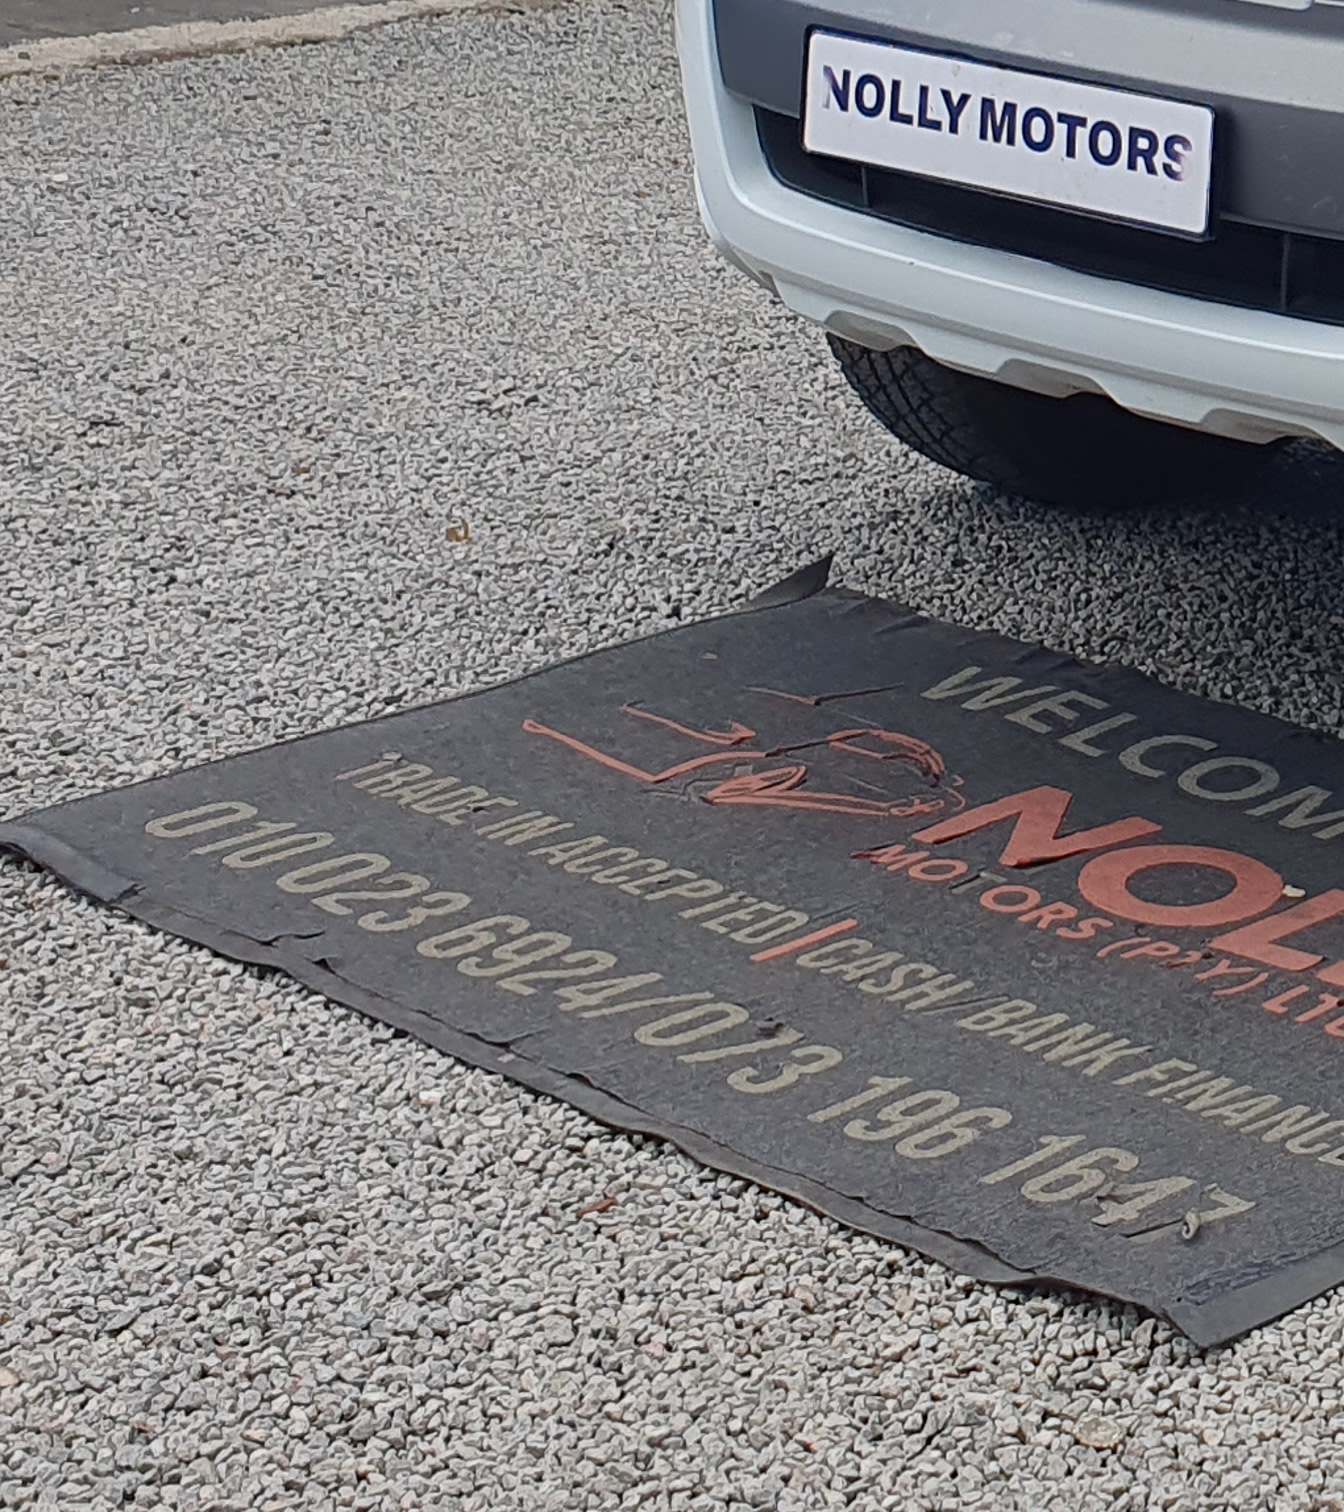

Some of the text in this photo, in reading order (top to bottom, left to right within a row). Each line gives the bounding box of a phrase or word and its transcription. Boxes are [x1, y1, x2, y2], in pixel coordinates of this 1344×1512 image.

[822, 64, 1193, 182] NOLLY MOTORS
[334, 751, 520, 826] TRADE
[476, 810, 576, 846] IN
[528, 834, 810, 945] ACCEPTED
[852, 843, 1114, 940] MOTORS
[144, 800, 336, 869] 010
[276, 852, 472, 932] 023
[807, 1076, 1013, 1160] 196
[979, 1133, 1257, 1244] 1647
